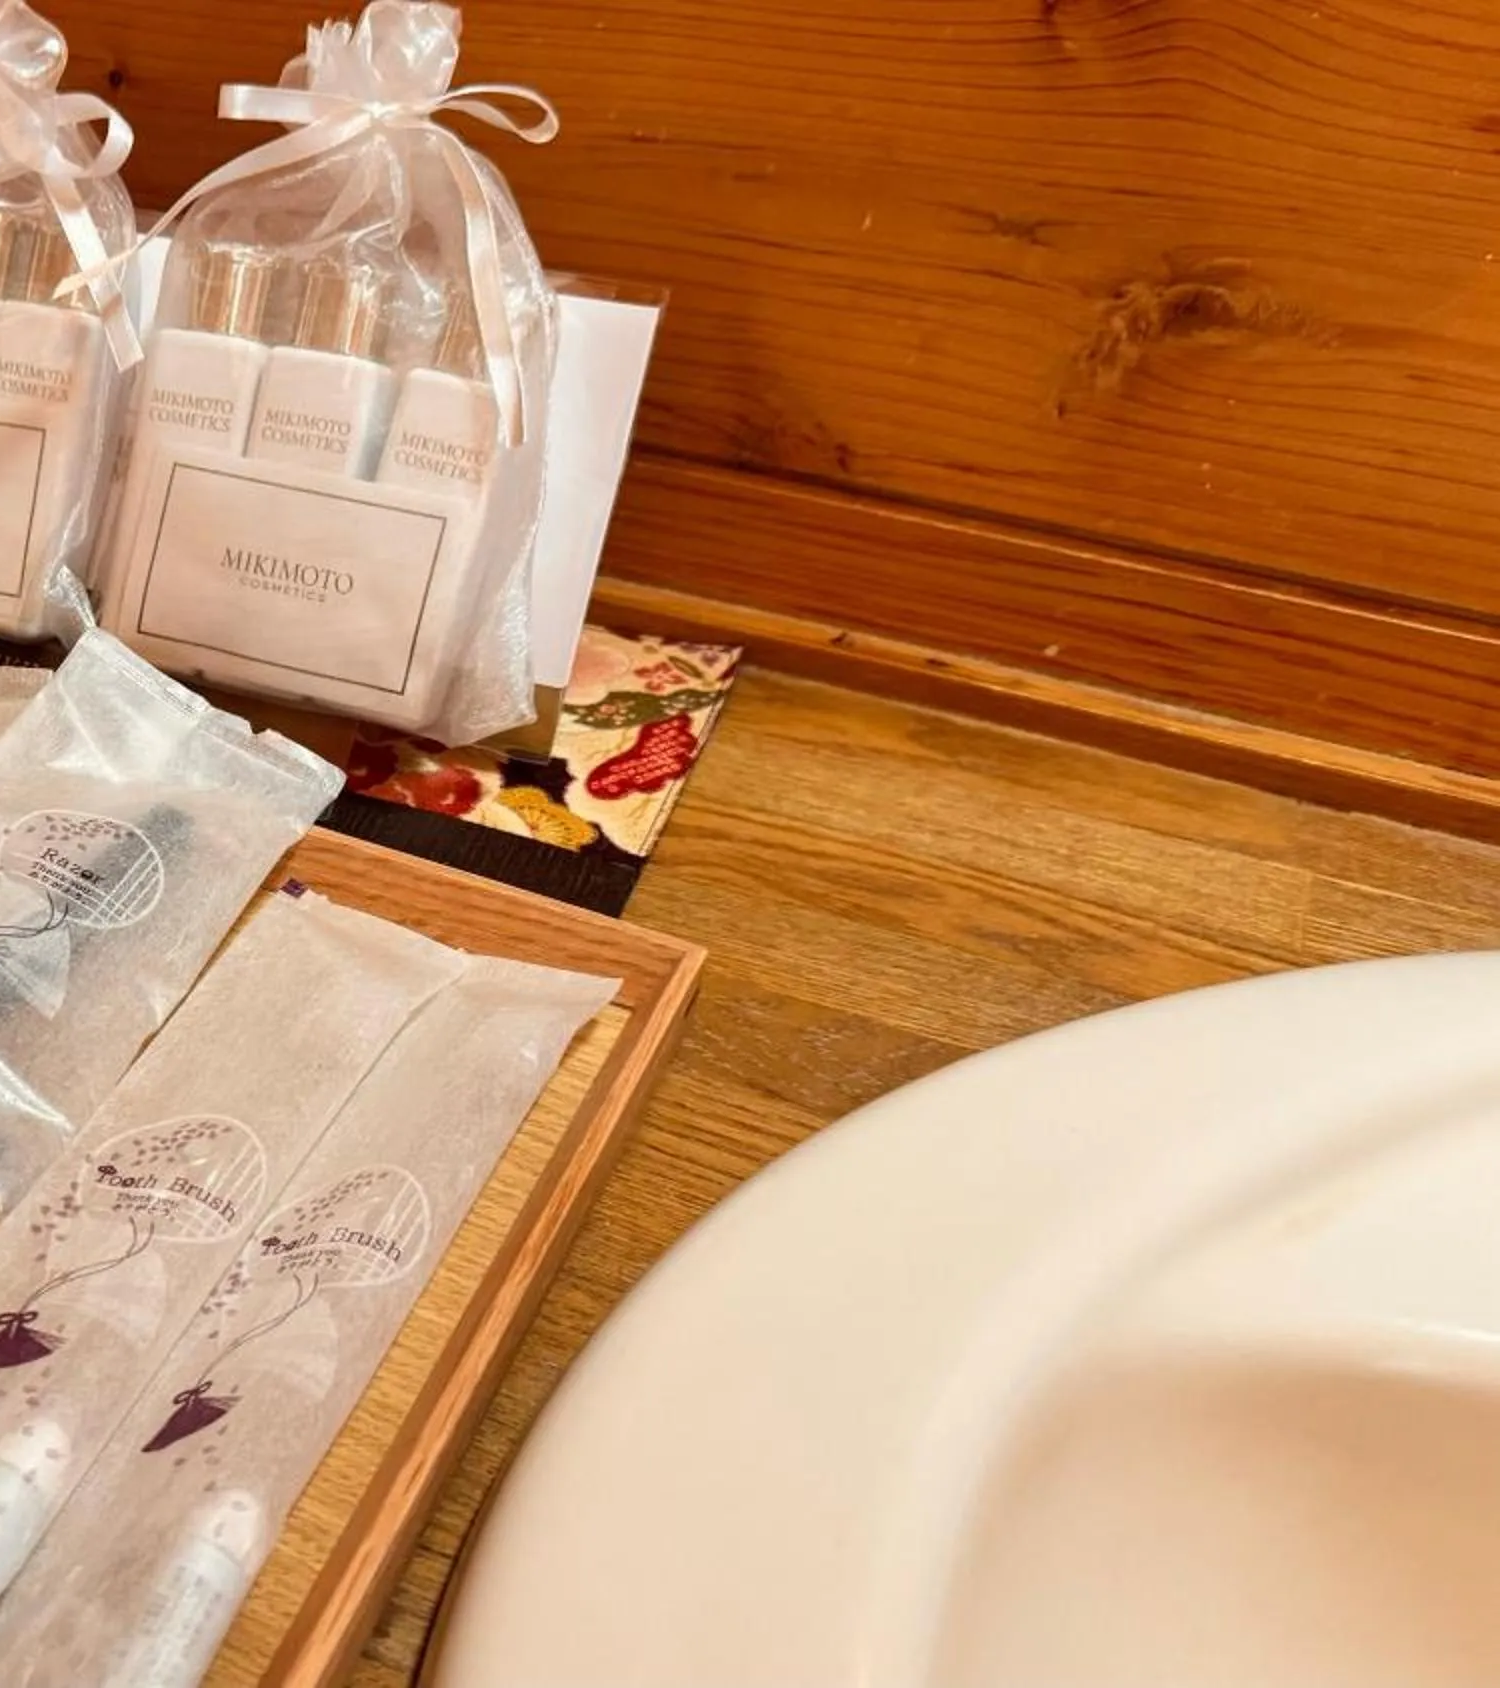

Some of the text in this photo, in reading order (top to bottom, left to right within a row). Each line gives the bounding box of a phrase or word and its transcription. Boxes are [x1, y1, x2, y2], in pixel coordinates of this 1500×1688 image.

[153, 388, 235, 415] MIKIMOTO
[148, 407, 231, 433] COSMETICS
[265, 408, 351, 437] MIKIMOTO
[261, 426, 348, 455] COSMETICS
[400, 431, 488, 467] MIKIMOTO
[394, 449, 482, 485] COSMETICS
[221, 547, 354, 596] MIKIMOTO
[238, 576, 326, 603] COSMETICS
[40, 847, 104, 885] Razor
[95, 1164, 237, 1223] Tooth Brush
[261, 1226, 402, 1262] Tooth Brush
